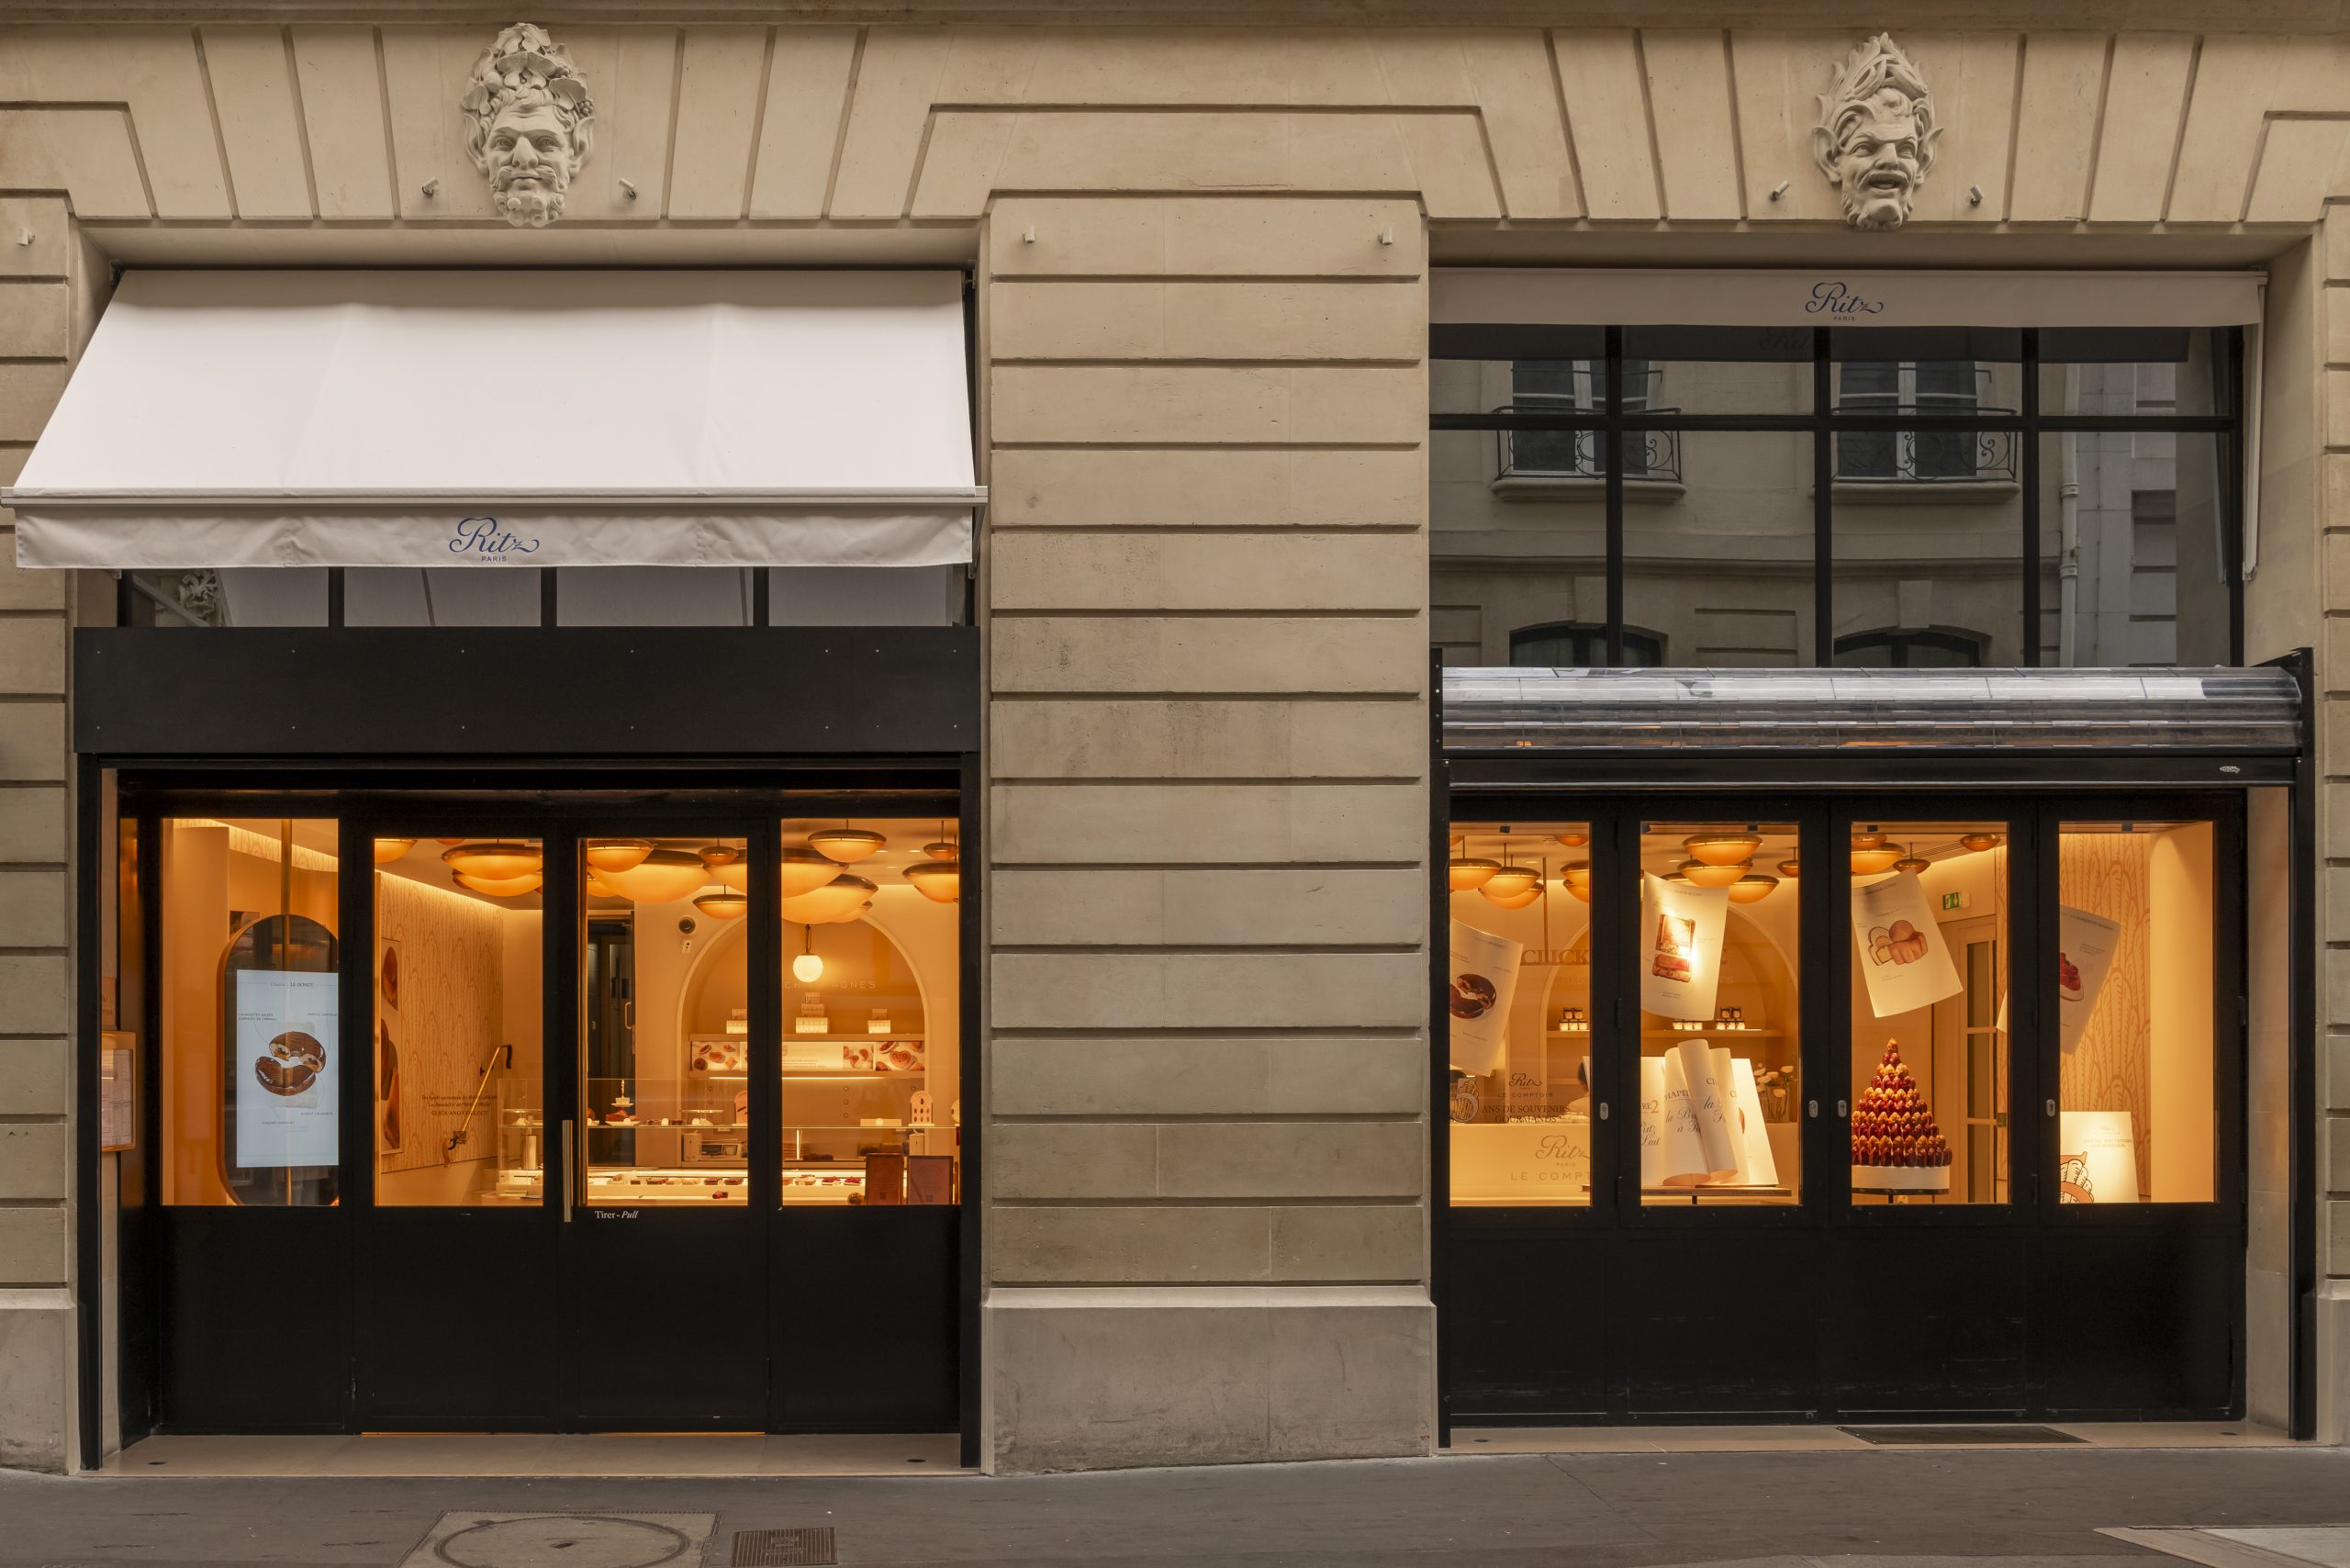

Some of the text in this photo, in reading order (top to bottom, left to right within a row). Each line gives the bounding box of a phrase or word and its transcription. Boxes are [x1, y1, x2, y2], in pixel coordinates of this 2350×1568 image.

[1805, 282, 1884, 313] Ritz
[449, 517, 540, 553] Ritz
[1508, 1072, 1543, 1087] Ritz
[1483, 1104, 1500, 1113] ANS
[1503, 1104, 1516, 1113] DE
[1518, 1104, 1571, 1113] SOUVENIRS
[1535, 1135, 1590, 1159] Ritz
[1511, 1172, 1528, 1181] LE
[595, 1210, 616, 1219] Tirer
[621, 1210, 639, 1219] Pull
